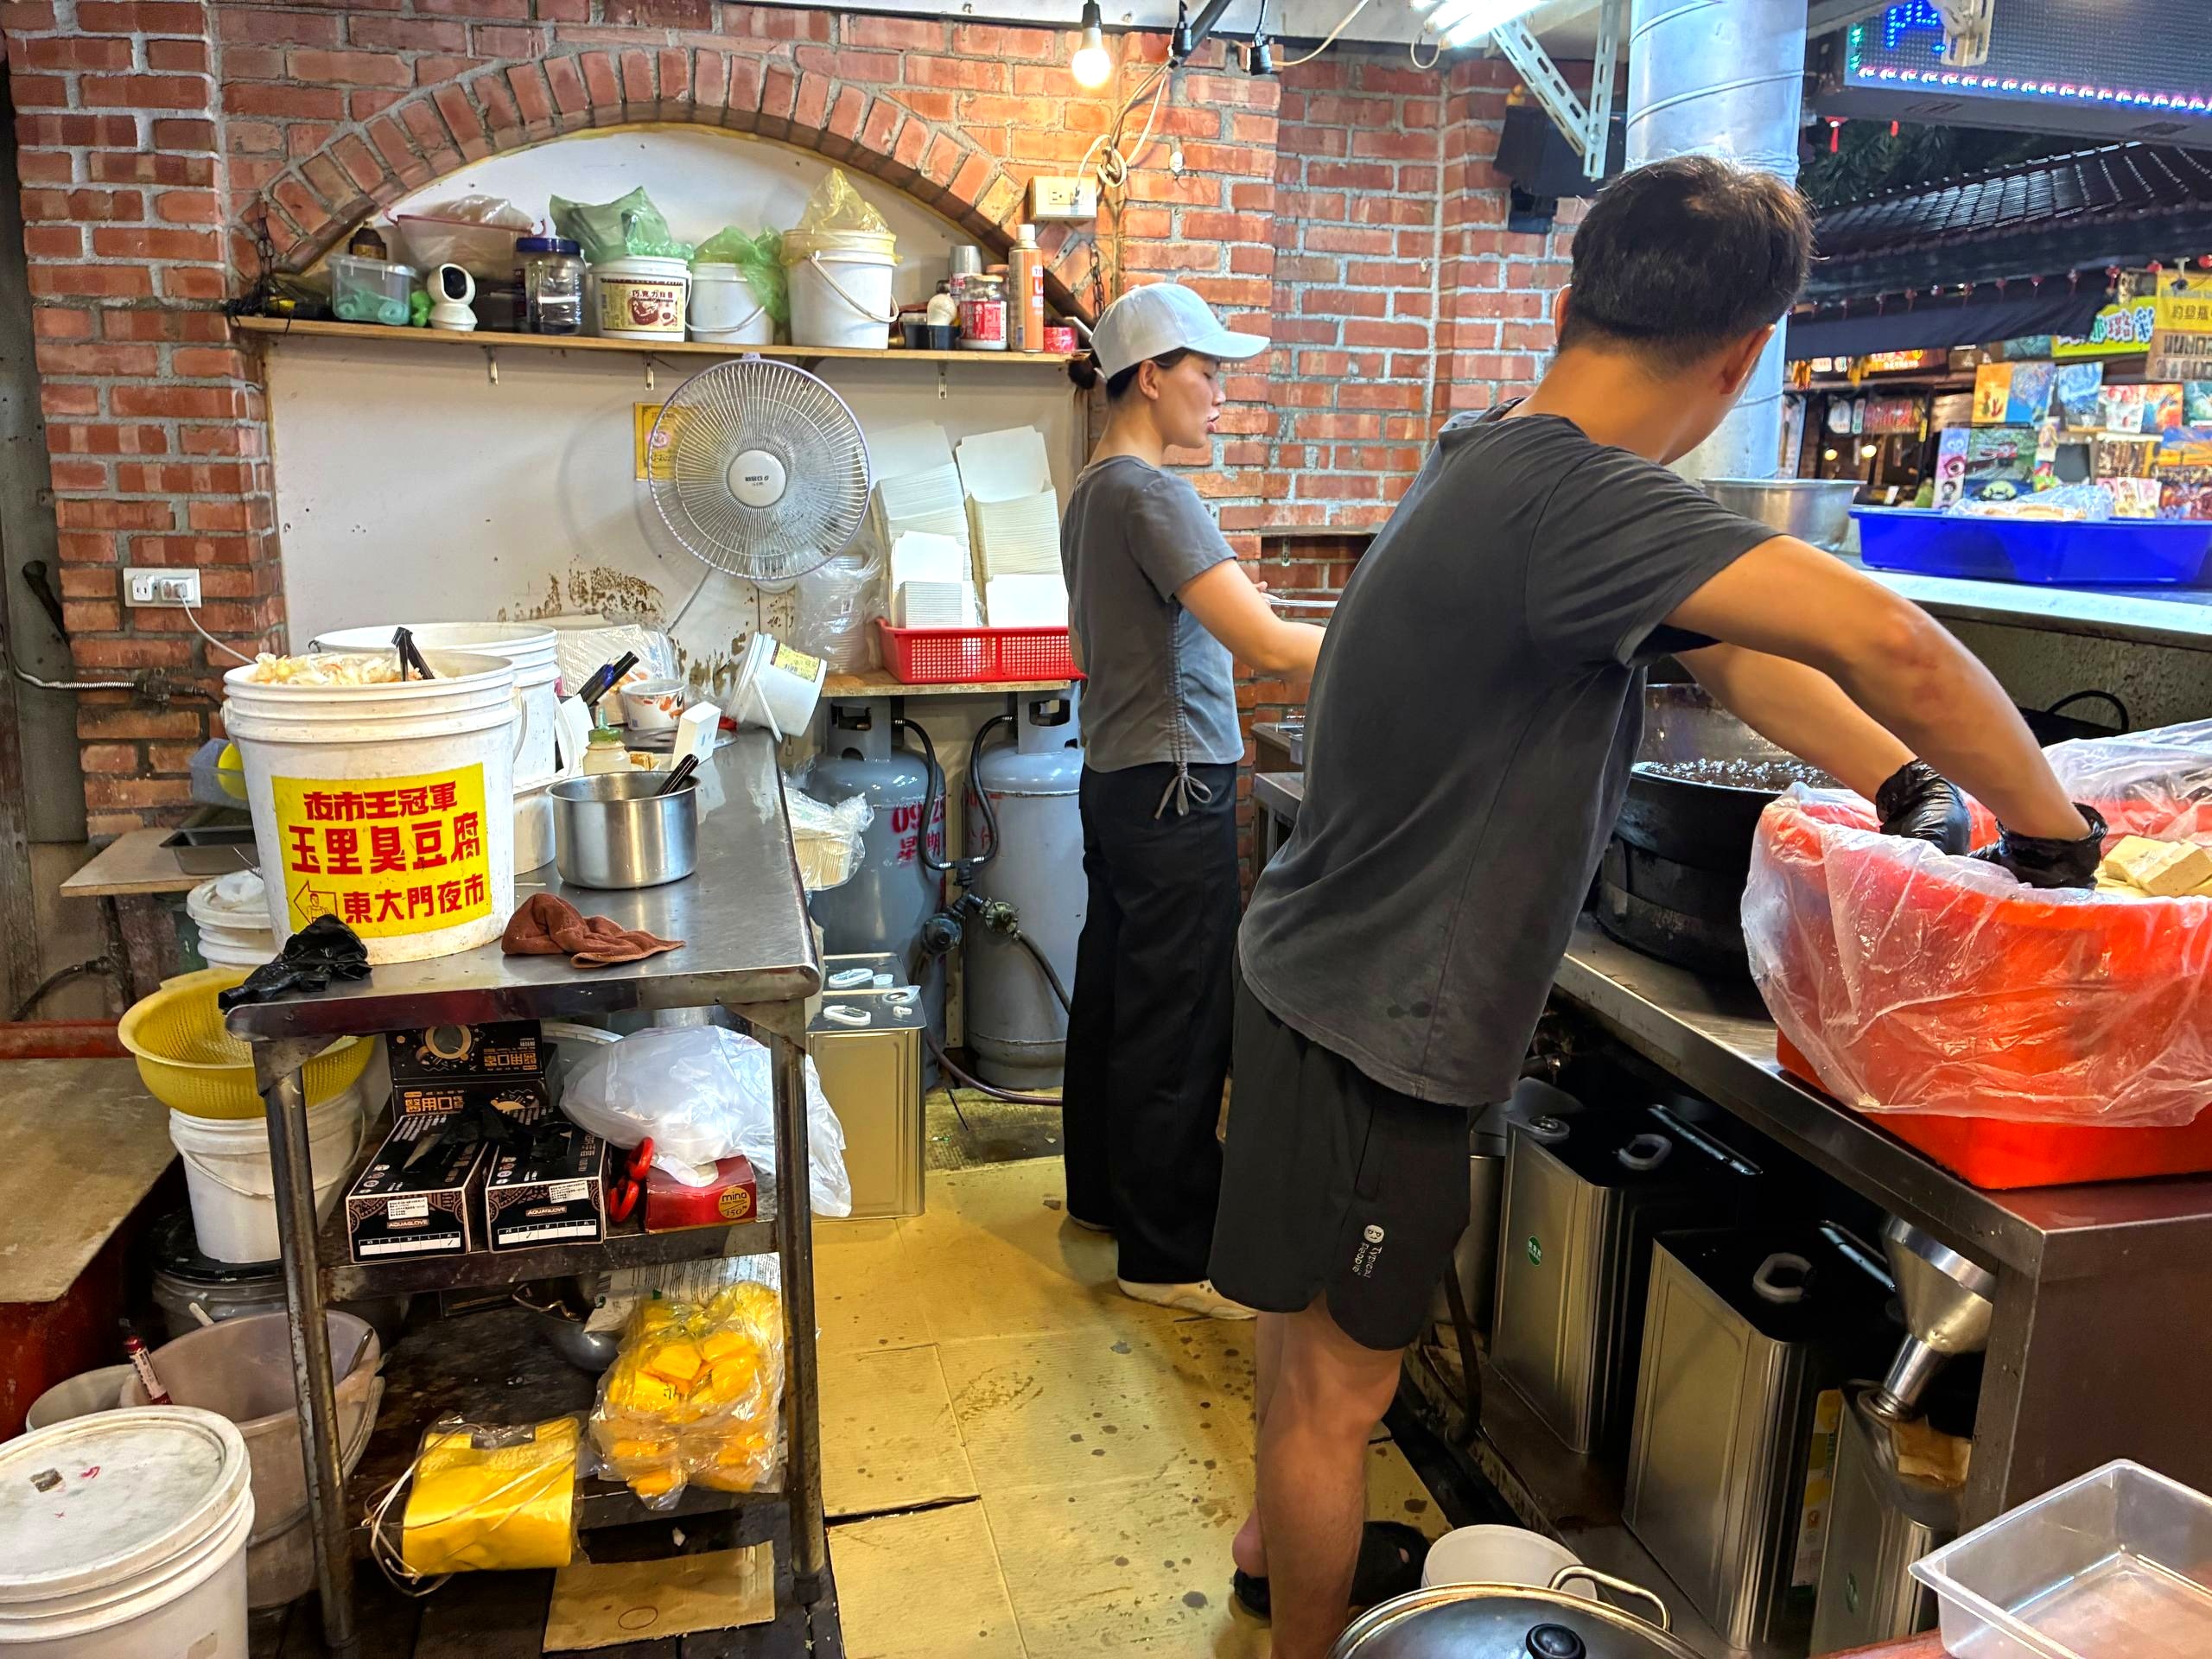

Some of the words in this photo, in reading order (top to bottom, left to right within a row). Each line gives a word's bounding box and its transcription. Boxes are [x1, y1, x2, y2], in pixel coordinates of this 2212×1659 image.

[303, 781, 458, 821] 夜市王冠軍
[289, 810, 480, 874] 玉里臭豆腐
[342, 873, 485, 924] 東大門夜市
[388, 1218, 430, 1228] AQUAGLOVE
[526, 1206, 566, 1216] AQUAGLOVE
